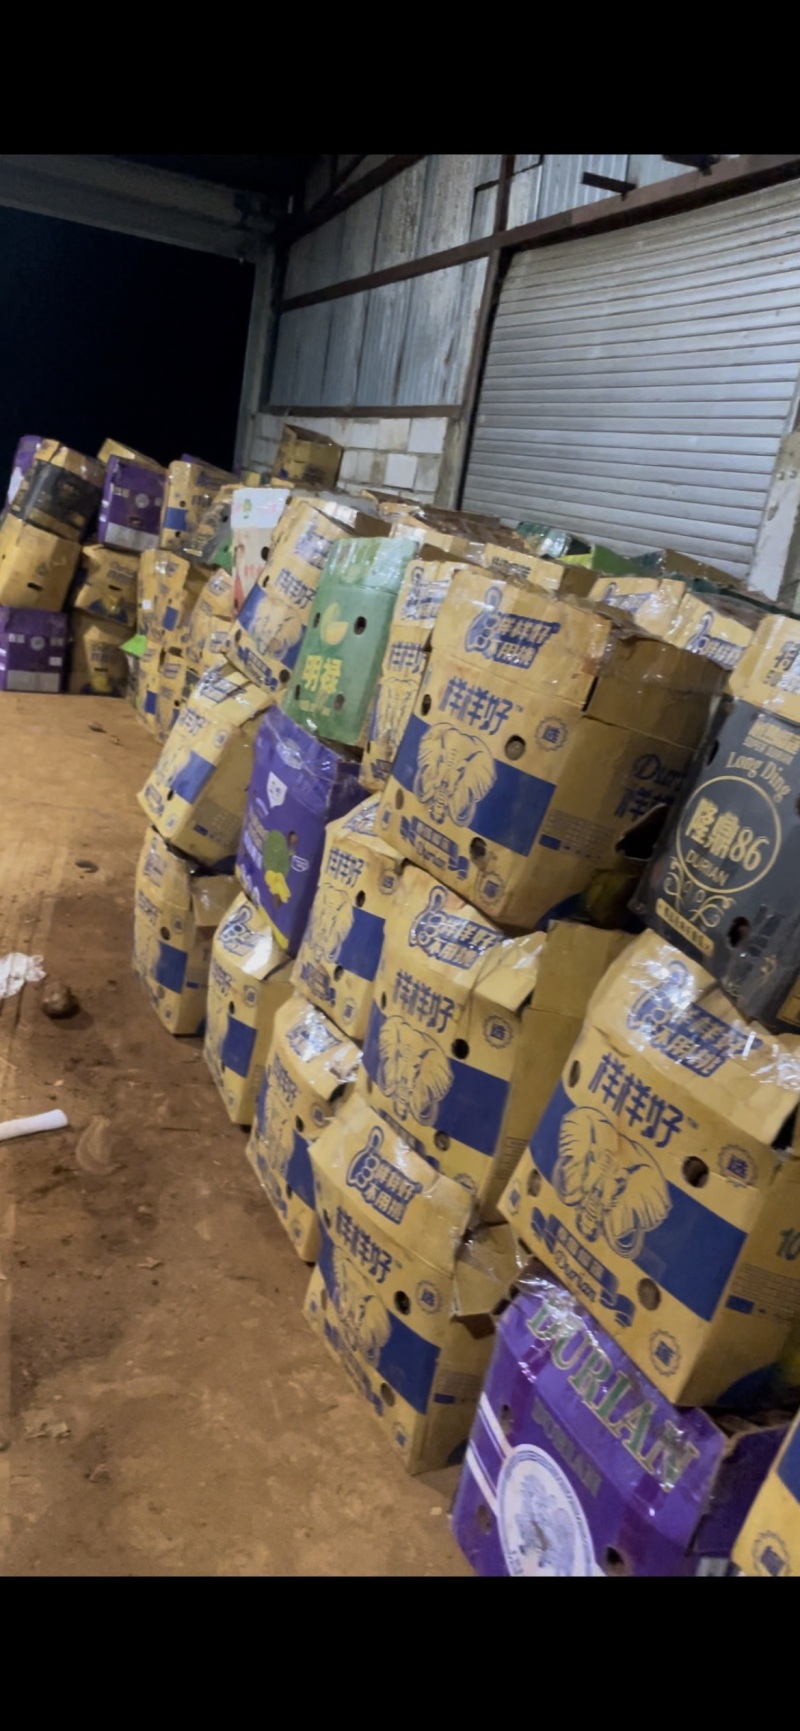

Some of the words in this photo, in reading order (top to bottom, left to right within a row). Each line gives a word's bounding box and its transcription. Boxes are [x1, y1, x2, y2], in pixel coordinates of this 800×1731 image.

[438, 675, 514, 735] 样样好
[726, 752, 763, 778] Long
[761, 761, 792, 803] Ding
[686, 850, 729, 886] DURIAN
[588, 1052, 685, 1149] 样样好
[526, 1296, 699, 1493] DURIAN
